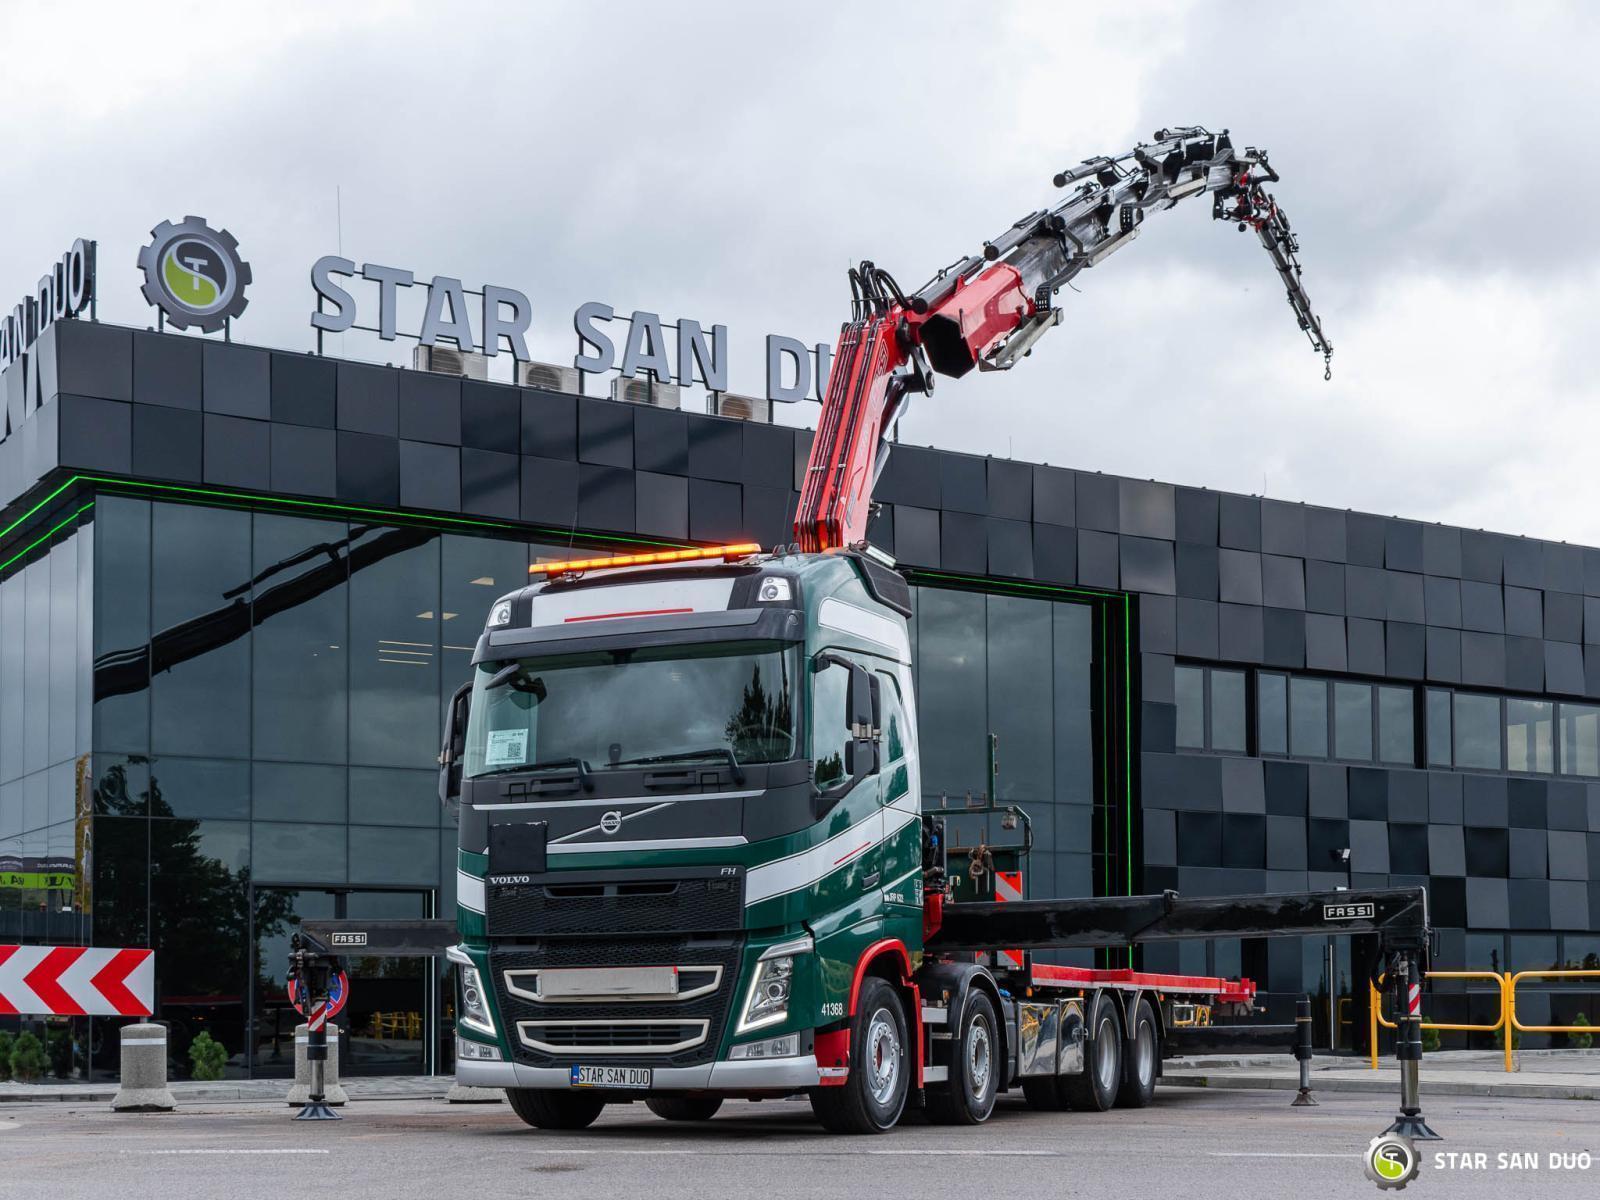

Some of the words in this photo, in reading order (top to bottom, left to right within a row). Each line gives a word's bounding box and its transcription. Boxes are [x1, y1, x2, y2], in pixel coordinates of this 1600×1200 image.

[310, 255, 532, 361] STAR
[574, 301, 727, 392] SAN
[0, 295, 34, 375] AN
[720, 867, 736, 876] FH
[489, 876, 530, 884] VOLVO
[1327, 906, 1371, 917] FASSI
[334, 935, 365, 943] FASSI
[821, 1002, 843, 1016] 41368
[579, 1067, 603, 1083] STAR
[607, 1068, 626, 1084] SAN
[629, 1069, 649, 1085] DUO
